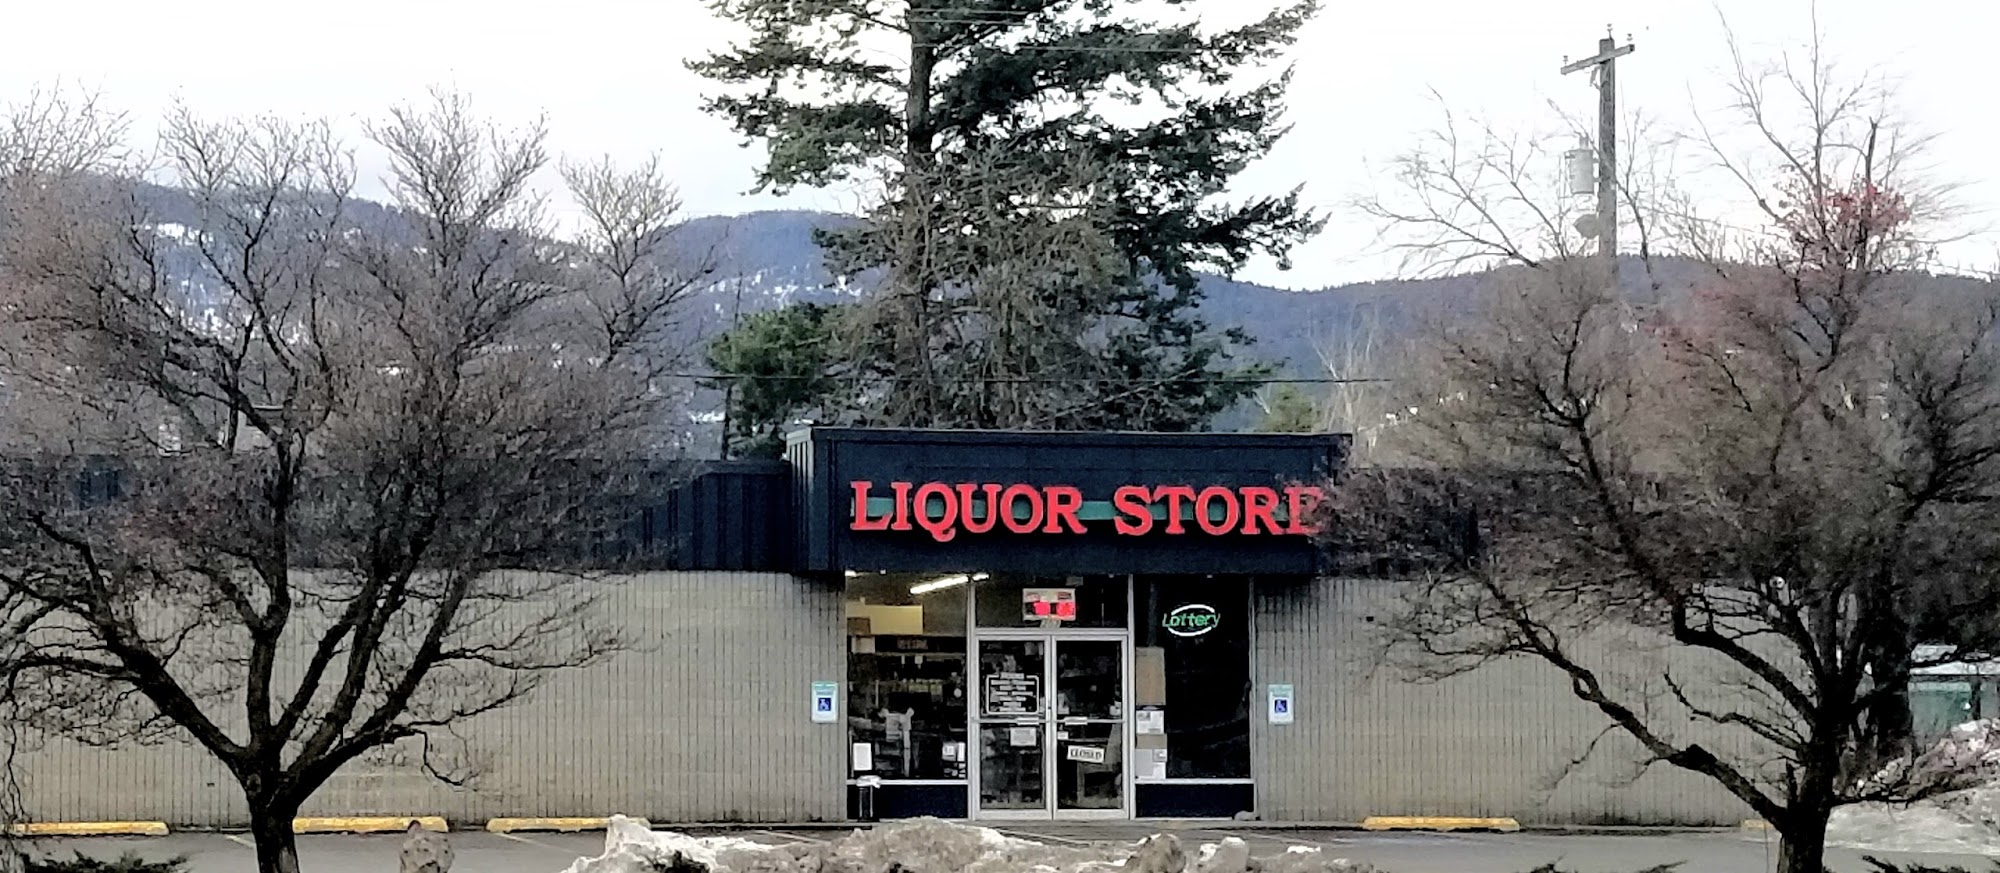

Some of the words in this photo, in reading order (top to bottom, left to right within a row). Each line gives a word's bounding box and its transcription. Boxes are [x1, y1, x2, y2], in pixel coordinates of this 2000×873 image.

[850, 480, 1088, 542] LIQUOR
[1114, 485, 1324, 536] STORE
[1162, 613, 1221, 628] Lottery
[1070, 748, 1102, 761] CLOSED
